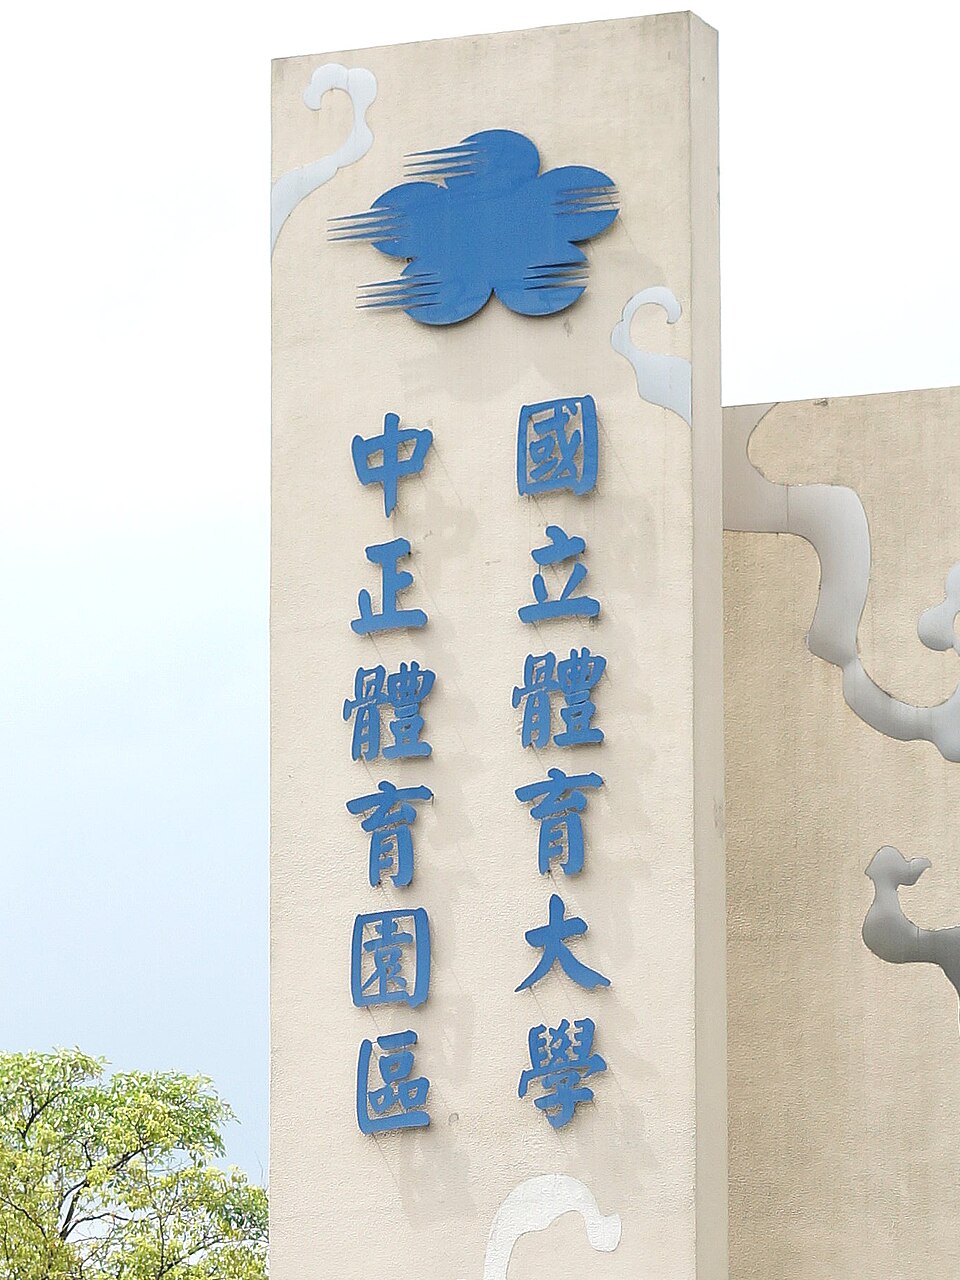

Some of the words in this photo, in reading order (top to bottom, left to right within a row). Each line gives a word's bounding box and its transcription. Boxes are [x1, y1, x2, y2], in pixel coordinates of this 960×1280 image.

[343, 412, 436, 1134] 中正體育園區
[514, 395, 611, 1129] 國立體育大學
